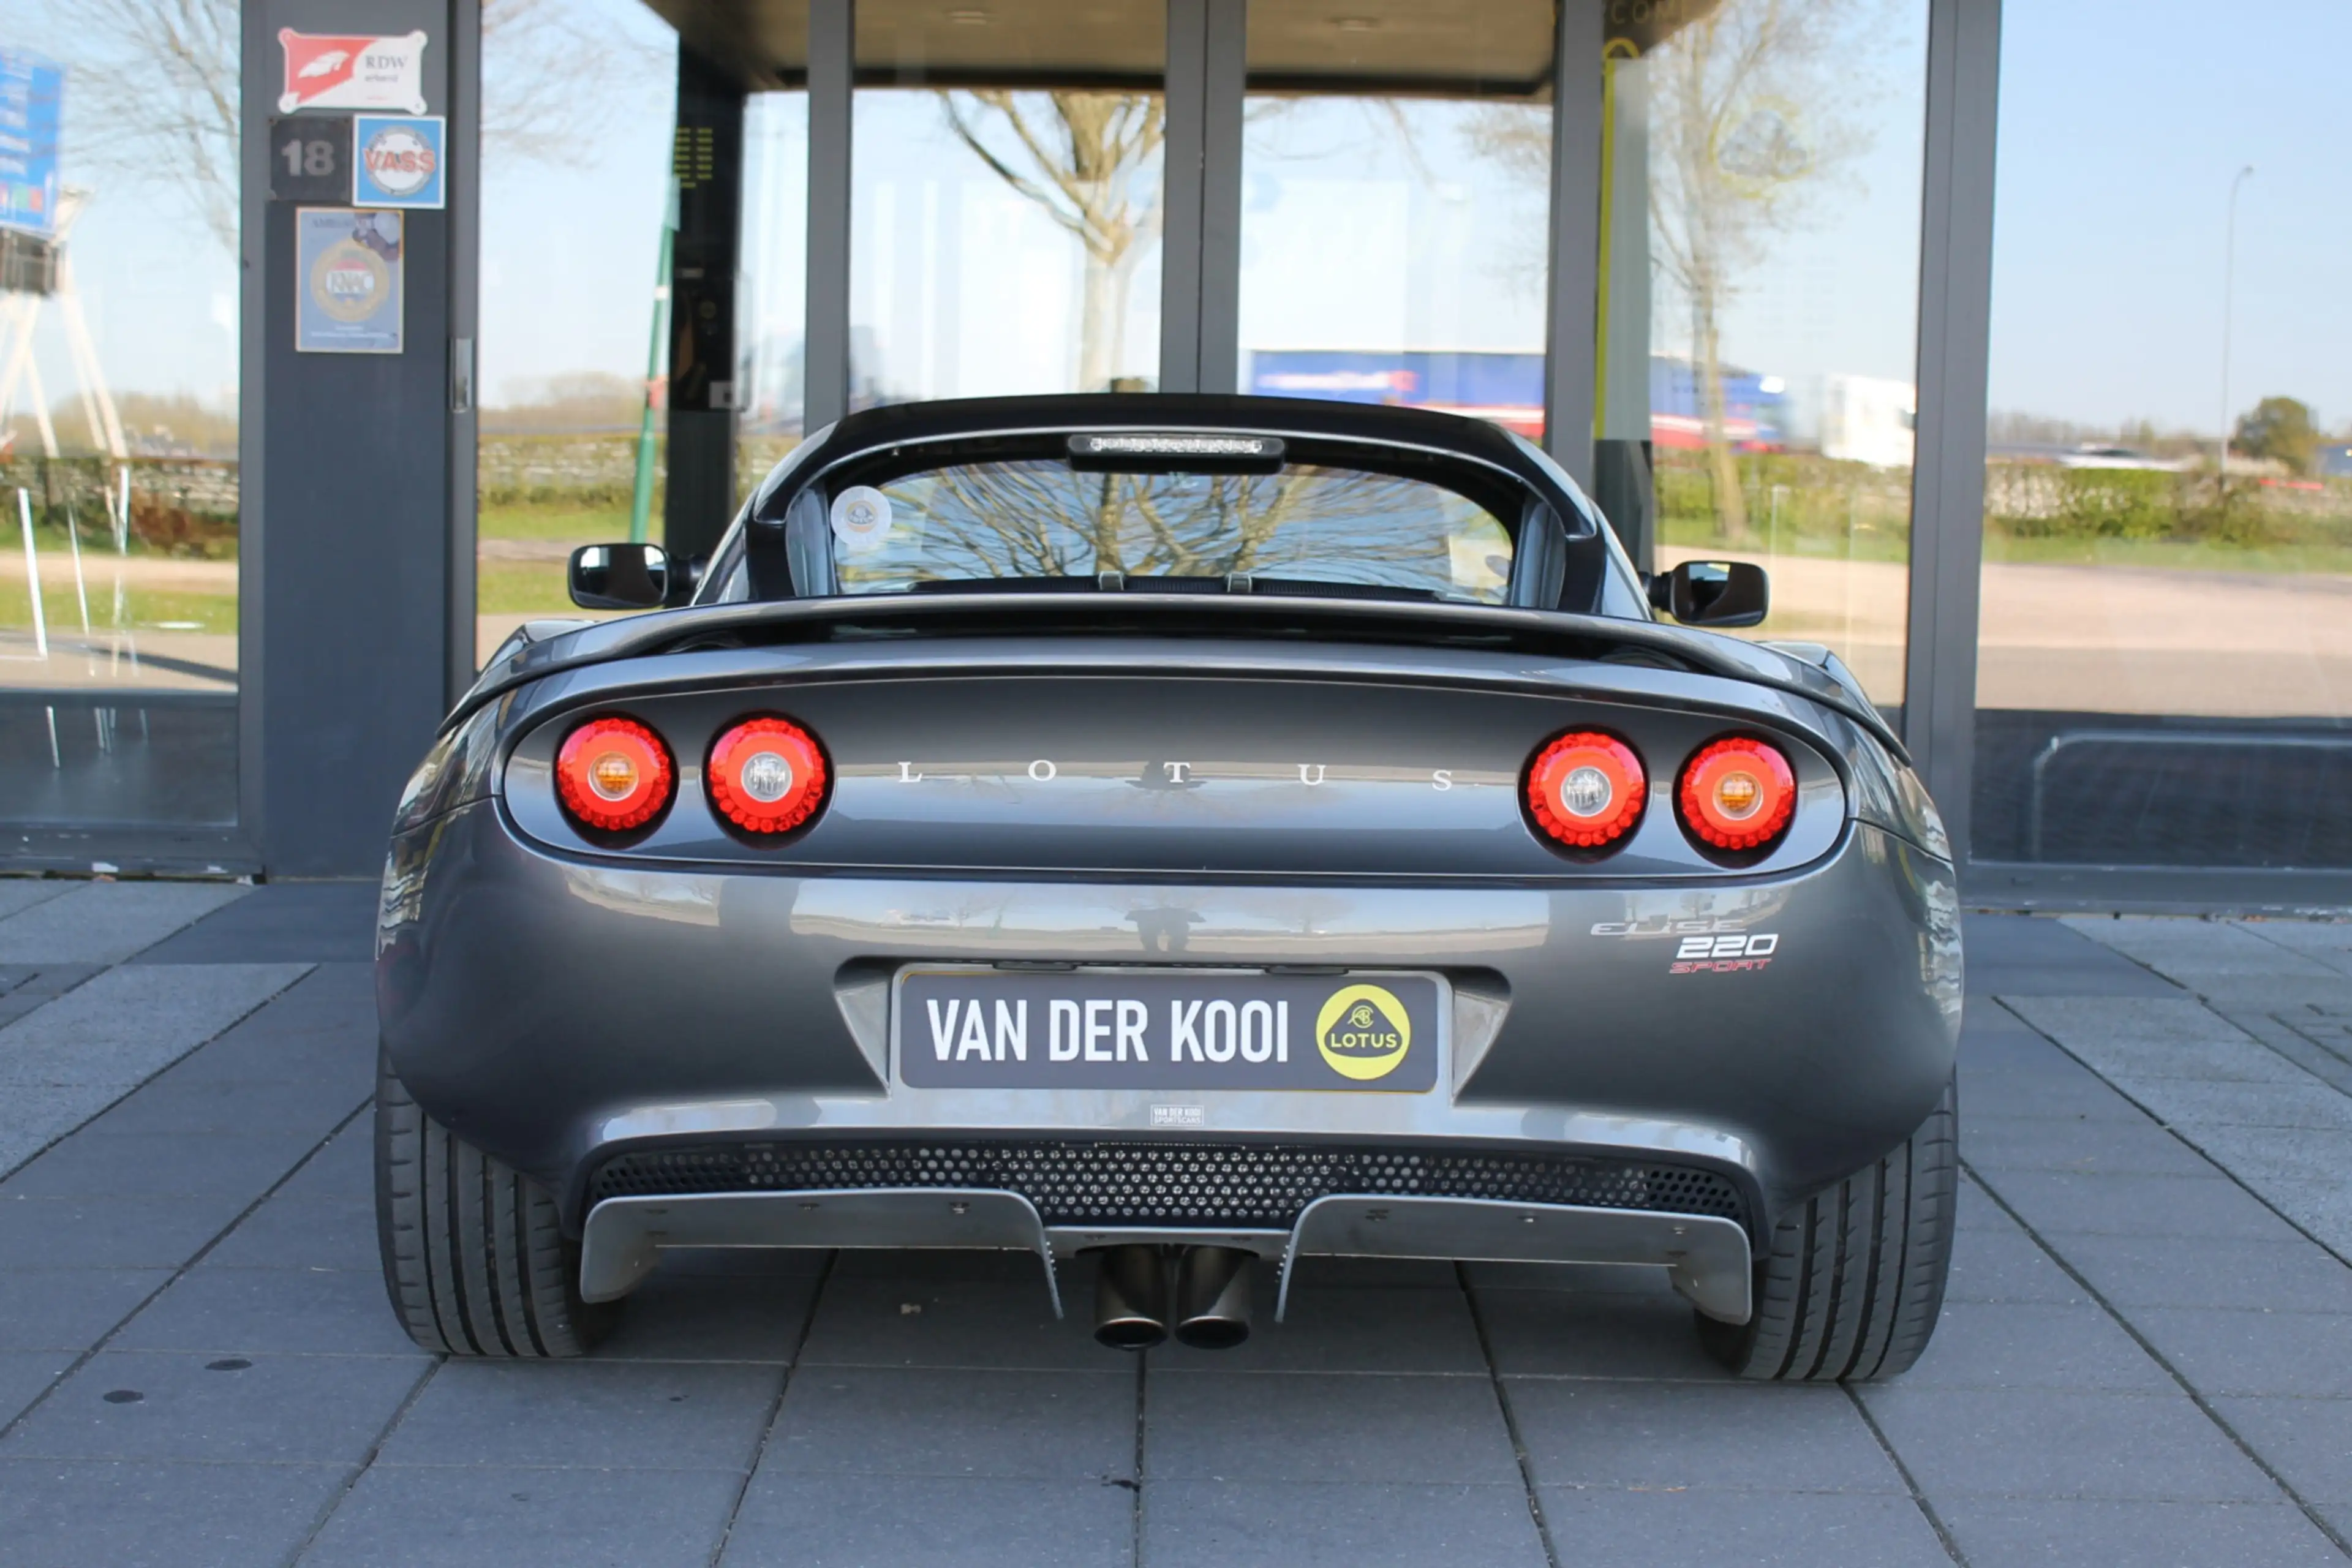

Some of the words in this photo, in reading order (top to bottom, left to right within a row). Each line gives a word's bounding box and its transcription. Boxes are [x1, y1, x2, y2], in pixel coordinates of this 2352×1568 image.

[365, 55, 409, 70] RDW
[281, 138, 335, 177] 18
[363, 148, 436, 173] VASS
[898, 760, 1453, 791] LOTUS
[1676, 933, 1779, 959] 220
[1669, 958, 1772, 974] SPORT
[926, 999, 1028, 1061] VAN
[1049, 999, 1150, 1062] DER
[1170, 1000, 1288, 1063] KOOI
[1331, 1033, 1397, 1049] LOTUS
[1169, 1107, 1183, 1117] DER
